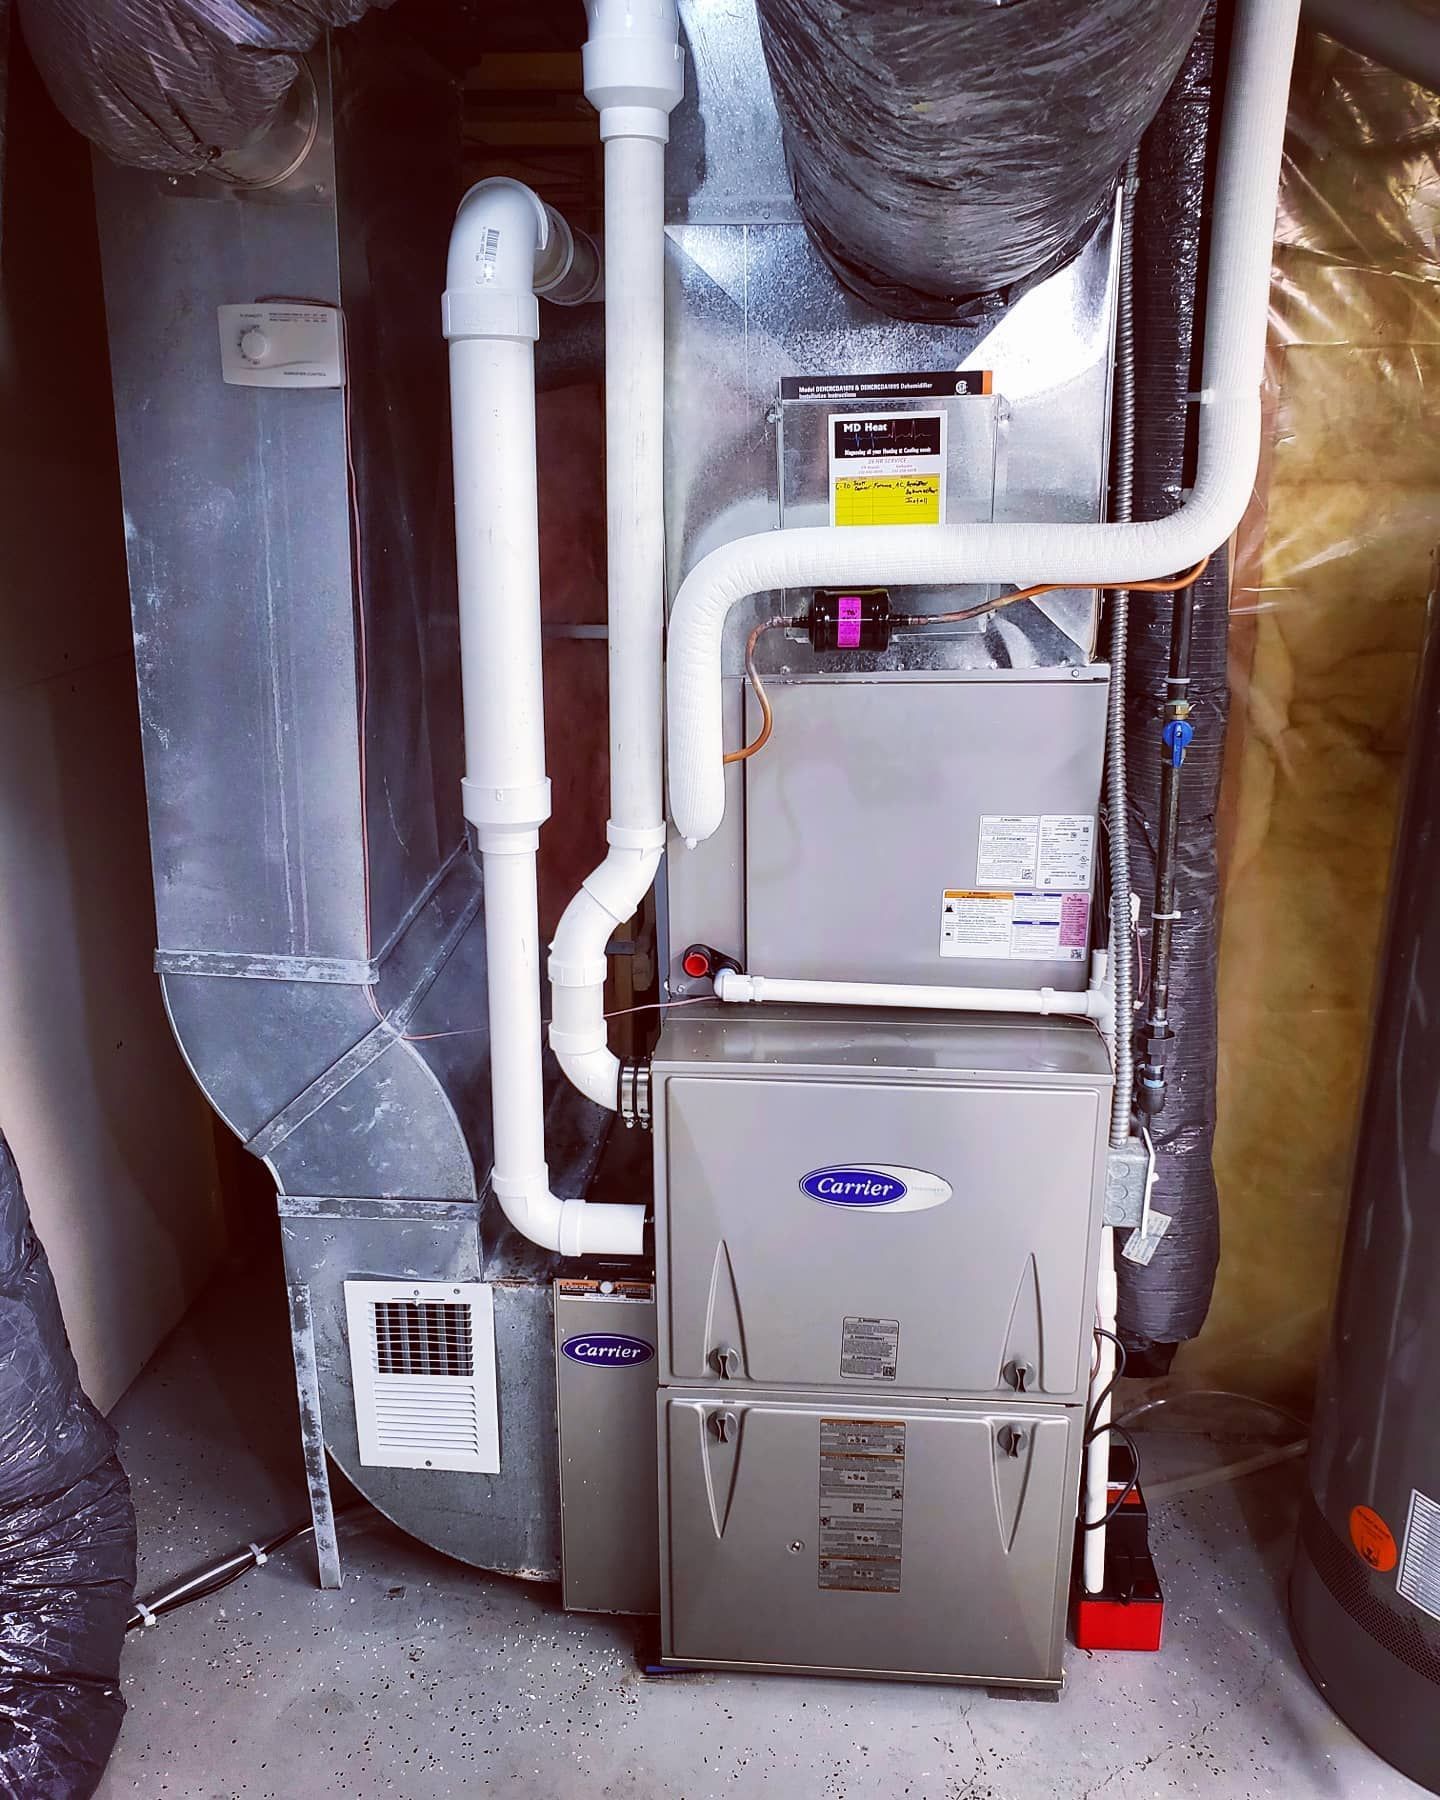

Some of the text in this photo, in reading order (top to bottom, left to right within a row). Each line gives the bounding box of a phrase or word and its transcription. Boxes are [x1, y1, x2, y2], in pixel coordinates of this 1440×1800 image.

[900, 382, 933, 390] Dehumidifier
[843, 422, 888, 432] MD Heat
[817, 1177, 893, 1196] Carrier
[574, 1343, 641, 1358] Carrier
